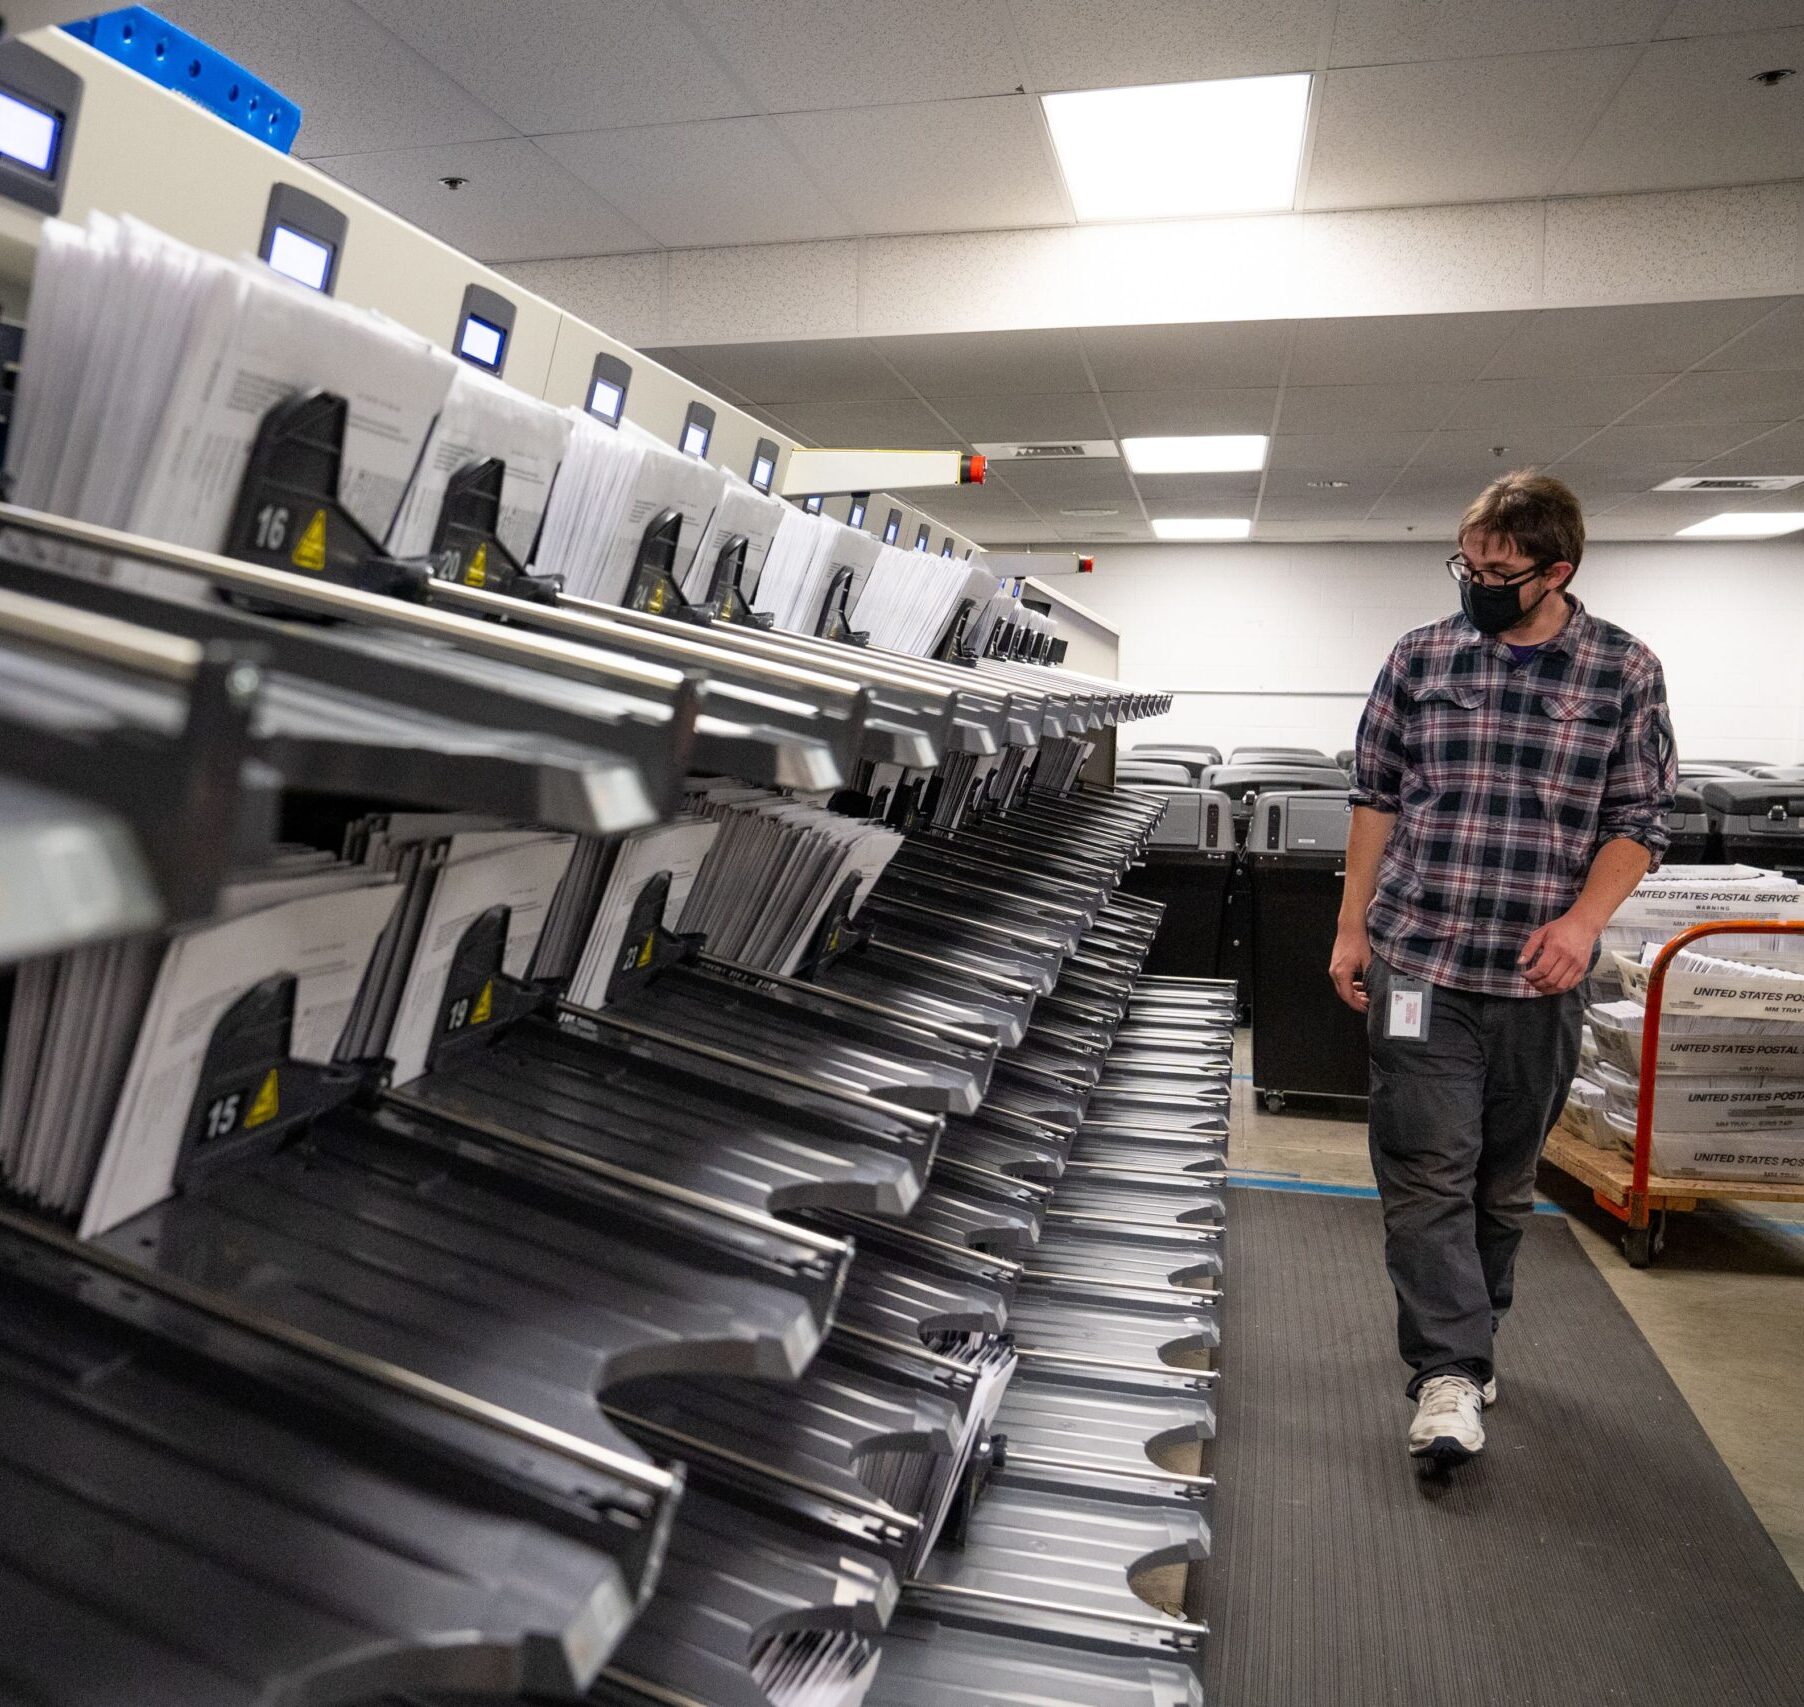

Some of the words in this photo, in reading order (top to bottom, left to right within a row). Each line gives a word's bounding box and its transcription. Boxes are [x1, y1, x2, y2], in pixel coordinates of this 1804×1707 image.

[256, 503, 289, 550] 16
[438, 549, 462, 582] 20
[1629, 890, 1667, 900] UNITED
[1668, 891, 1709, 901] STATES
[1711, 892, 1751, 902] POSTAL
[1754, 894, 1801, 903] SERVICE
[622, 945, 639, 971] 23
[1693, 986, 1737, 998] UNITED
[1739, 990, 1783, 1001] STATES
[448, 998, 469, 1031] 19
[1670, 1043, 1711, 1053] UNITED
[1711, 1044, 1756, 1054] STATES
[1756, 1045, 1799, 1055] POSTAL
[1688, 1093, 1729, 1102] UNITED
[1730, 1093, 1773, 1102] STATES
[208, 1093, 240, 1139] 15
[1693, 1152, 1735, 1163] UNITED
[1737, 1155, 1780, 1166] STATES
